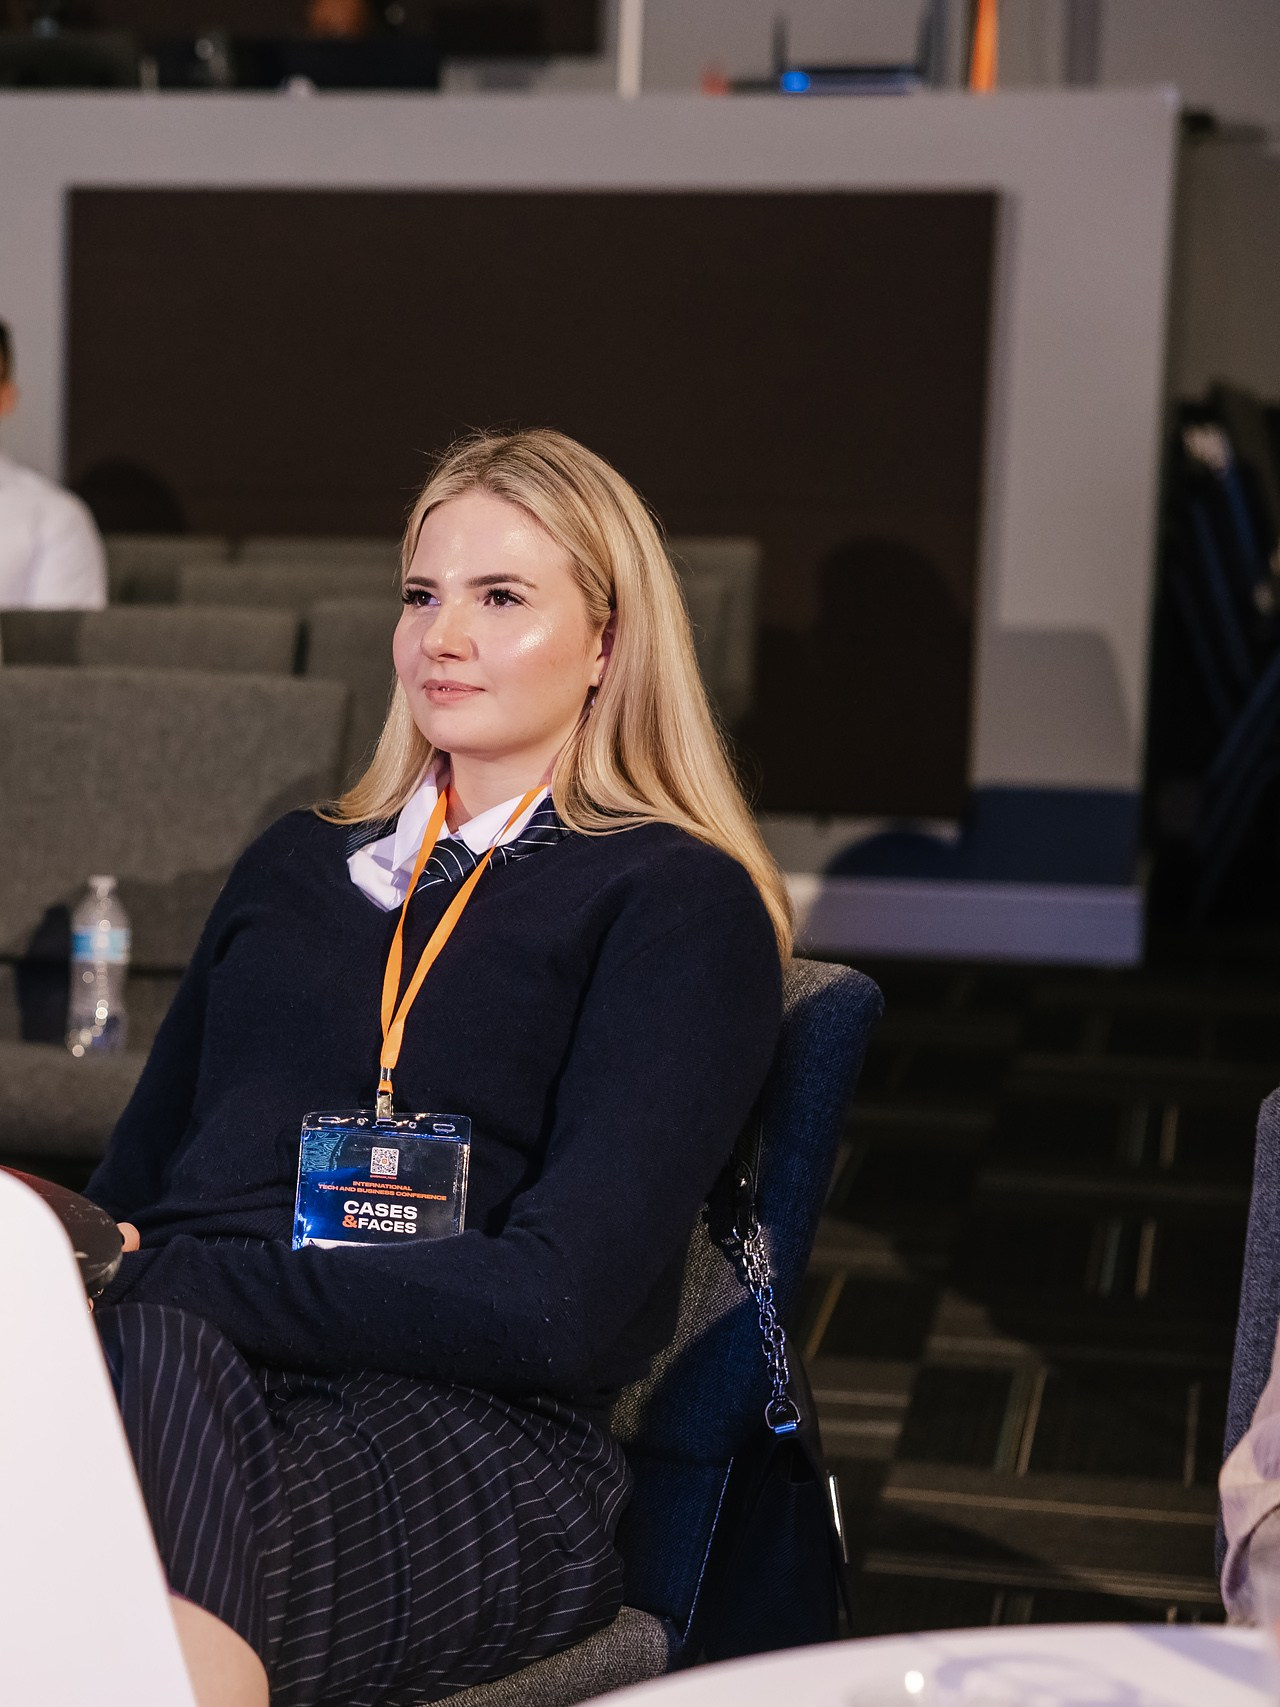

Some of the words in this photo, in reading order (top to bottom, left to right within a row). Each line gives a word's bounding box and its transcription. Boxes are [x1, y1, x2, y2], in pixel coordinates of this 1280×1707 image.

[318, 1183, 339, 1191] TECH
[357, 1188, 395, 1196] BUSINESS
[396, 1191, 447, 1201] CONFERENCE
[352, 1180, 413, 1191] INTERNATIONAL
[343, 1200, 418, 1220] CASES
